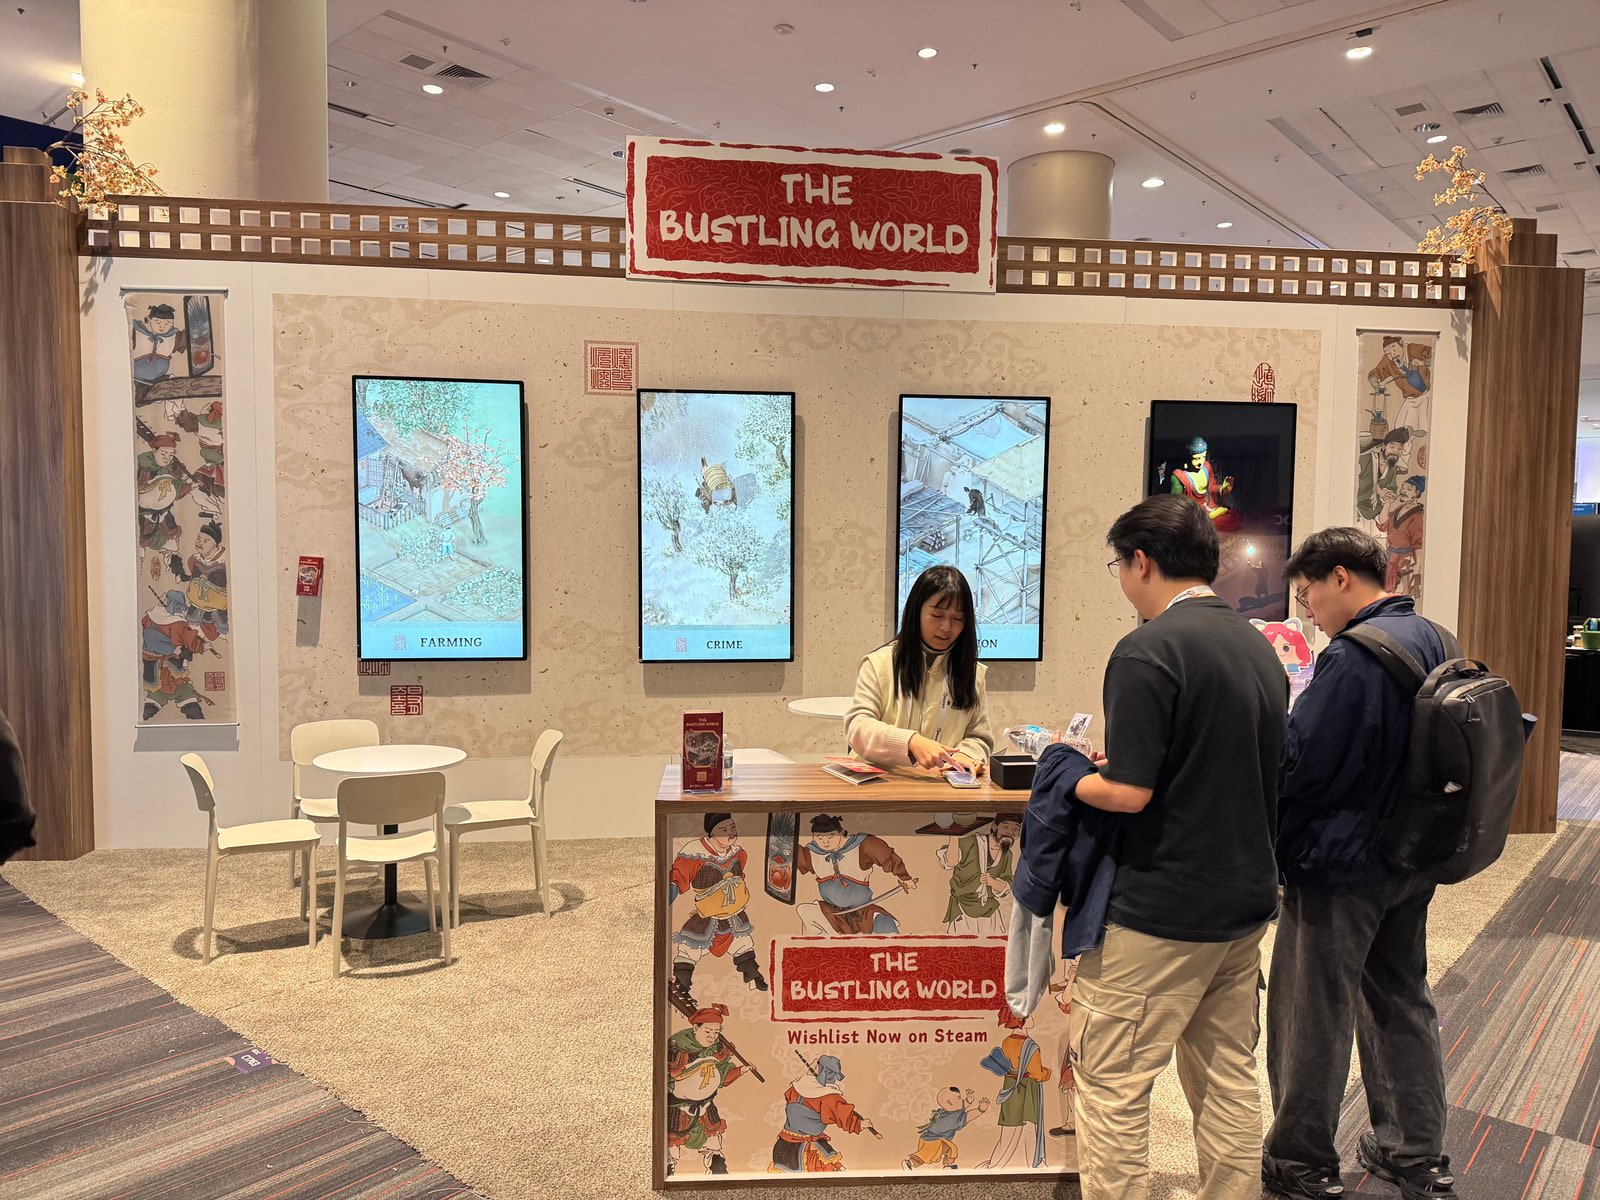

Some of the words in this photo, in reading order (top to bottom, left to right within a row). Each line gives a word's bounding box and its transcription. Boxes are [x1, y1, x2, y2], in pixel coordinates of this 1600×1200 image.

[780, 173, 853, 206] THE
[660, 209, 839, 249] BUSTLING
[850, 220, 968, 255] WORLD
[420, 637, 482, 647] FARMING
[706, 640, 743, 649] CRIME
[870, 951, 918, 972] THE
[790, 980, 911, 1000] BUSTLING
[917, 979, 997, 999] WORLD
[788, 1029, 859, 1044] Wishlist
[866, 1029, 901, 1044] Now
[908, 1032, 928, 1043] on
[934, 1028, 988, 1043] Steam
